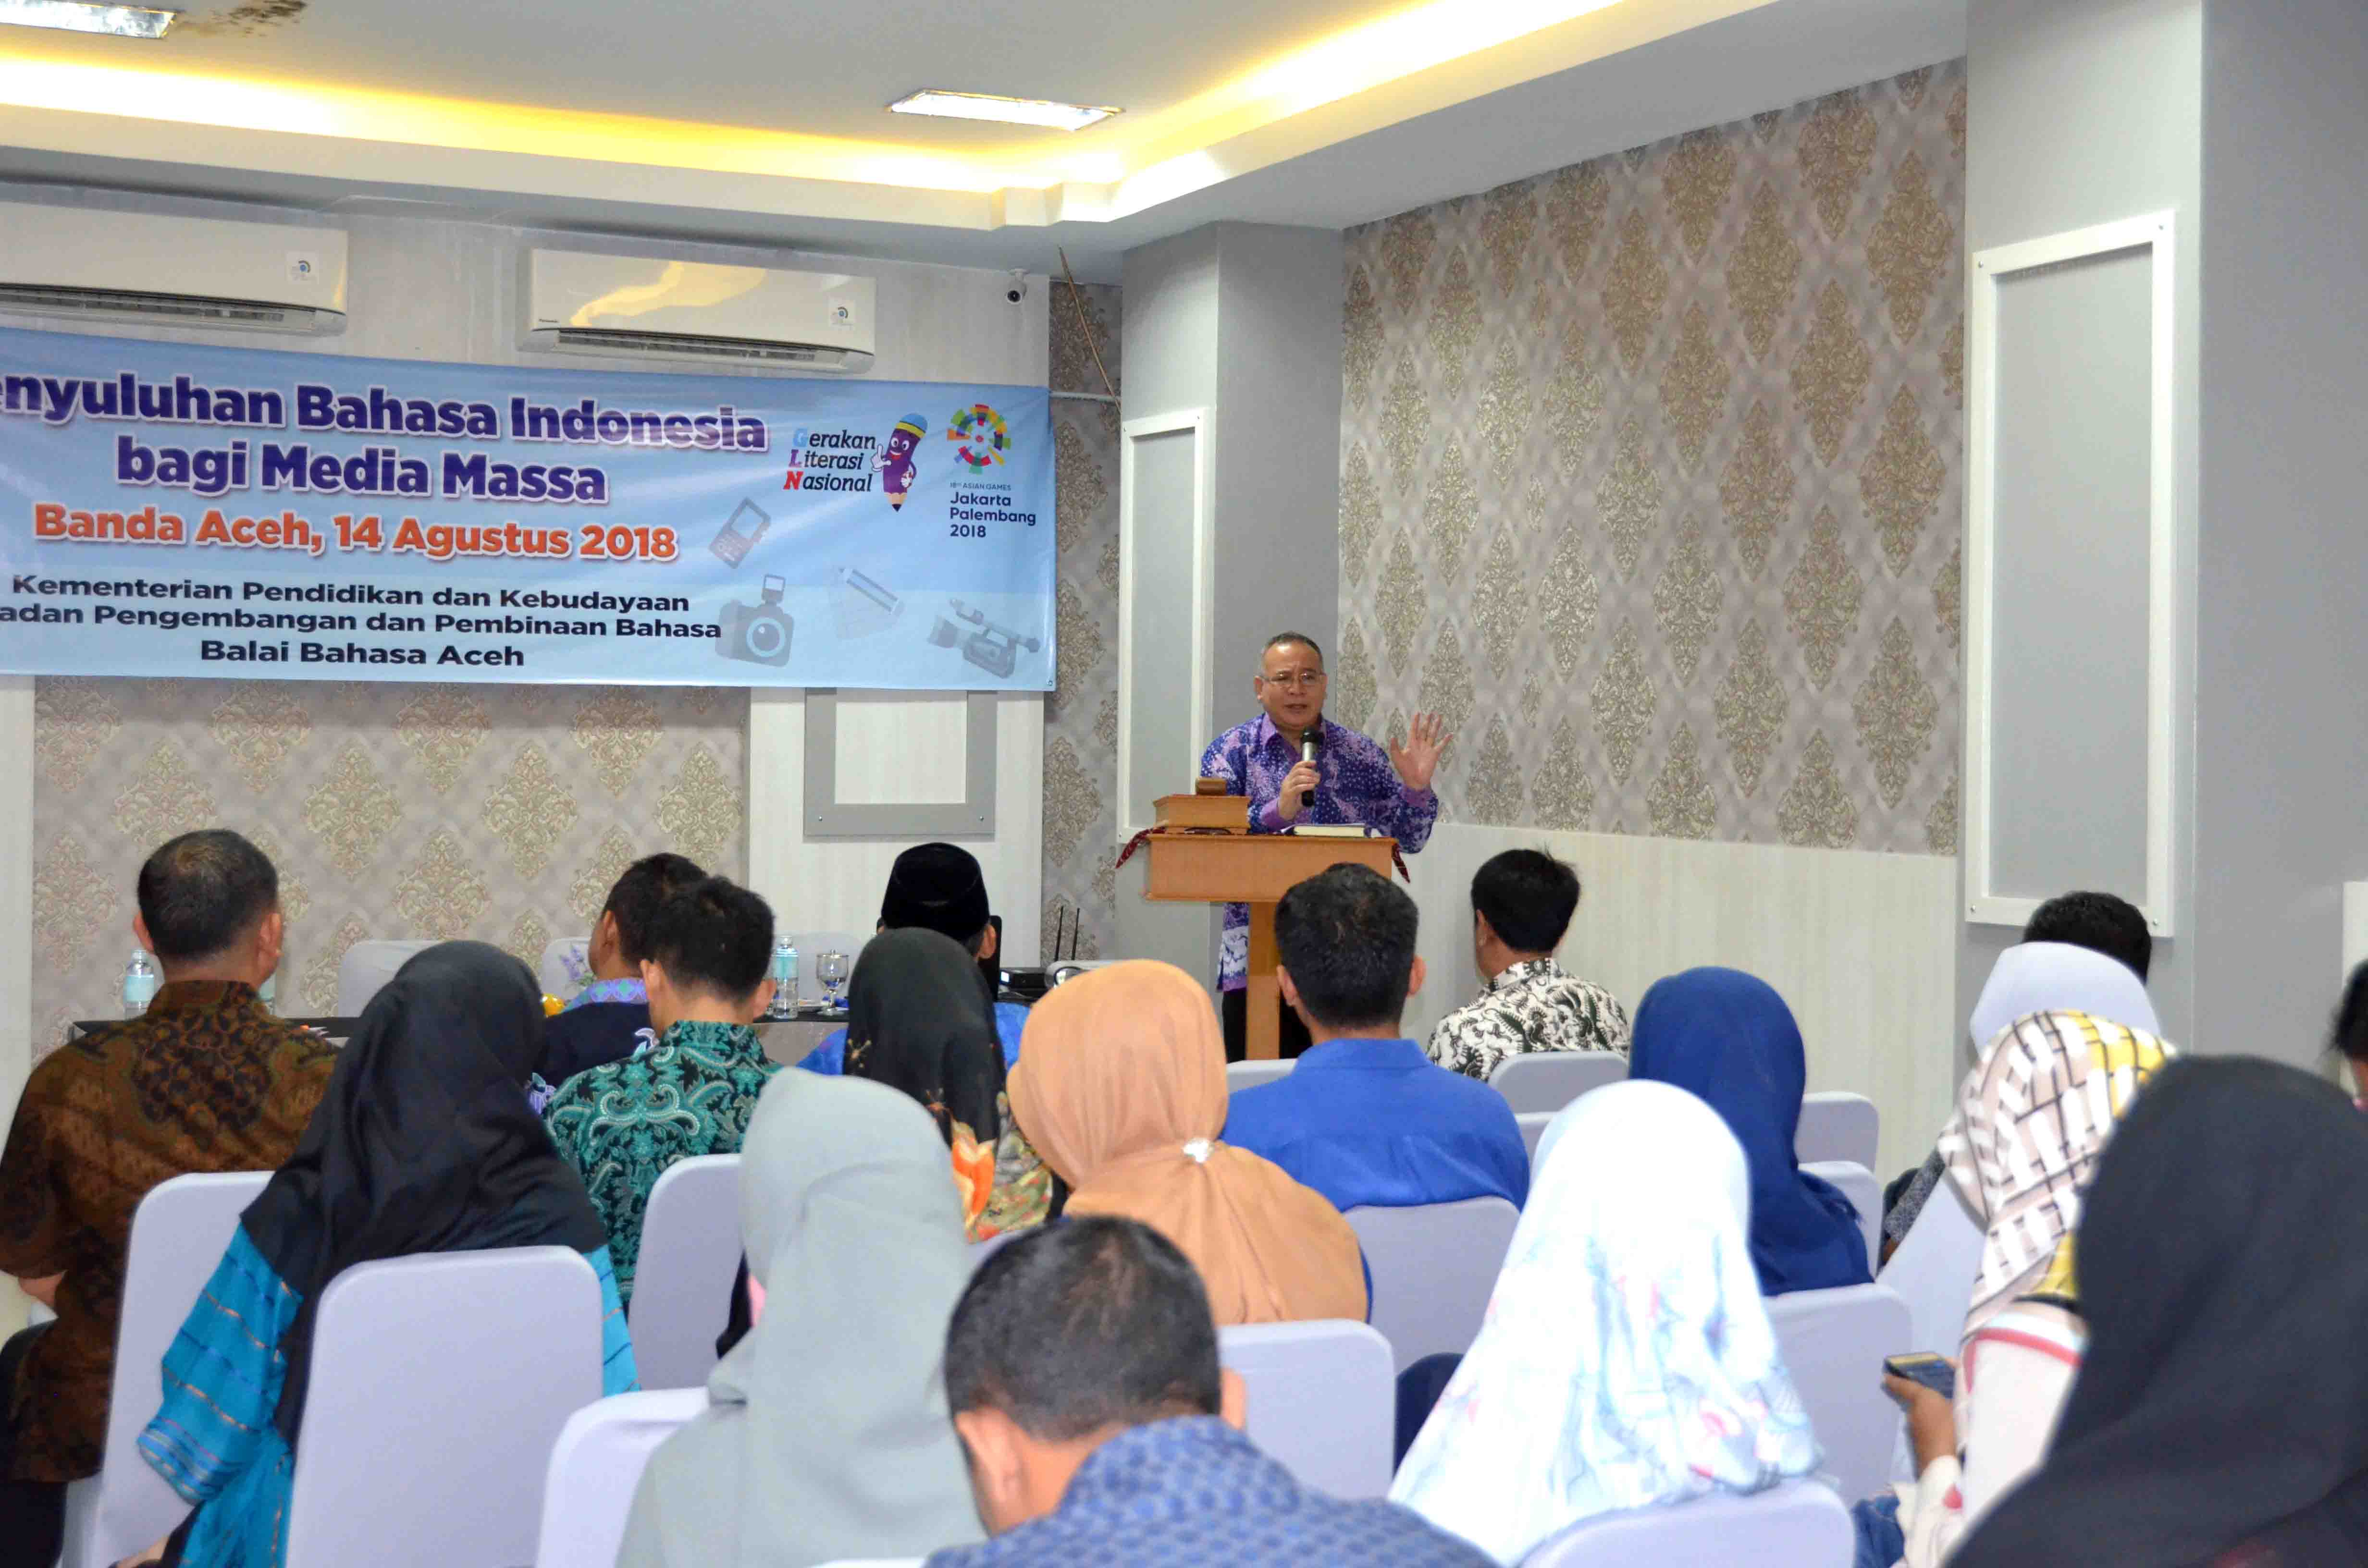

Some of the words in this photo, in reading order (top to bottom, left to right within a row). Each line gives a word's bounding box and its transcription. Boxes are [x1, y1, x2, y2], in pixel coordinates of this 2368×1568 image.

[0, 372, 283, 425] nyuluhan
[296, 384, 497, 436] Bahasa
[510, 397, 765, 450] Indonesia
[793, 429, 876, 450] Gerakan
[117, 435, 247, 493] bagi
[261, 443, 429, 495] Media
[443, 453, 605, 500] Massa
[789, 449, 864, 470] Literasi
[783, 471, 873, 492] Nasional
[950, 492, 1011, 506] Jakarta
[950, 507, 1036, 527] Palembang
[36, 504, 181, 539] Banda
[197, 511, 322, 552] Aceh,
[334, 516, 381, 546] 14
[394, 518, 569, 557] Agustus
[580, 525, 674, 557] 2018
[950, 524, 987, 538] 2018
[13, 575, 233, 600] Kementerian
[243, 582, 423, 605] Pendidikan
[432, 588, 491, 606] dan
[500, 589, 689, 617] Kebudayaan
[95, 605, 357, 633] Pengembangan
[366, 612, 425, 632] dan
[435, 614, 606, 636] Pembinaan
[616, 618, 721, 638] Bahasa
[201, 640, 289, 662] Balai
[300, 642, 427, 665] Bahasa
[437, 645, 524, 666] Aceh
